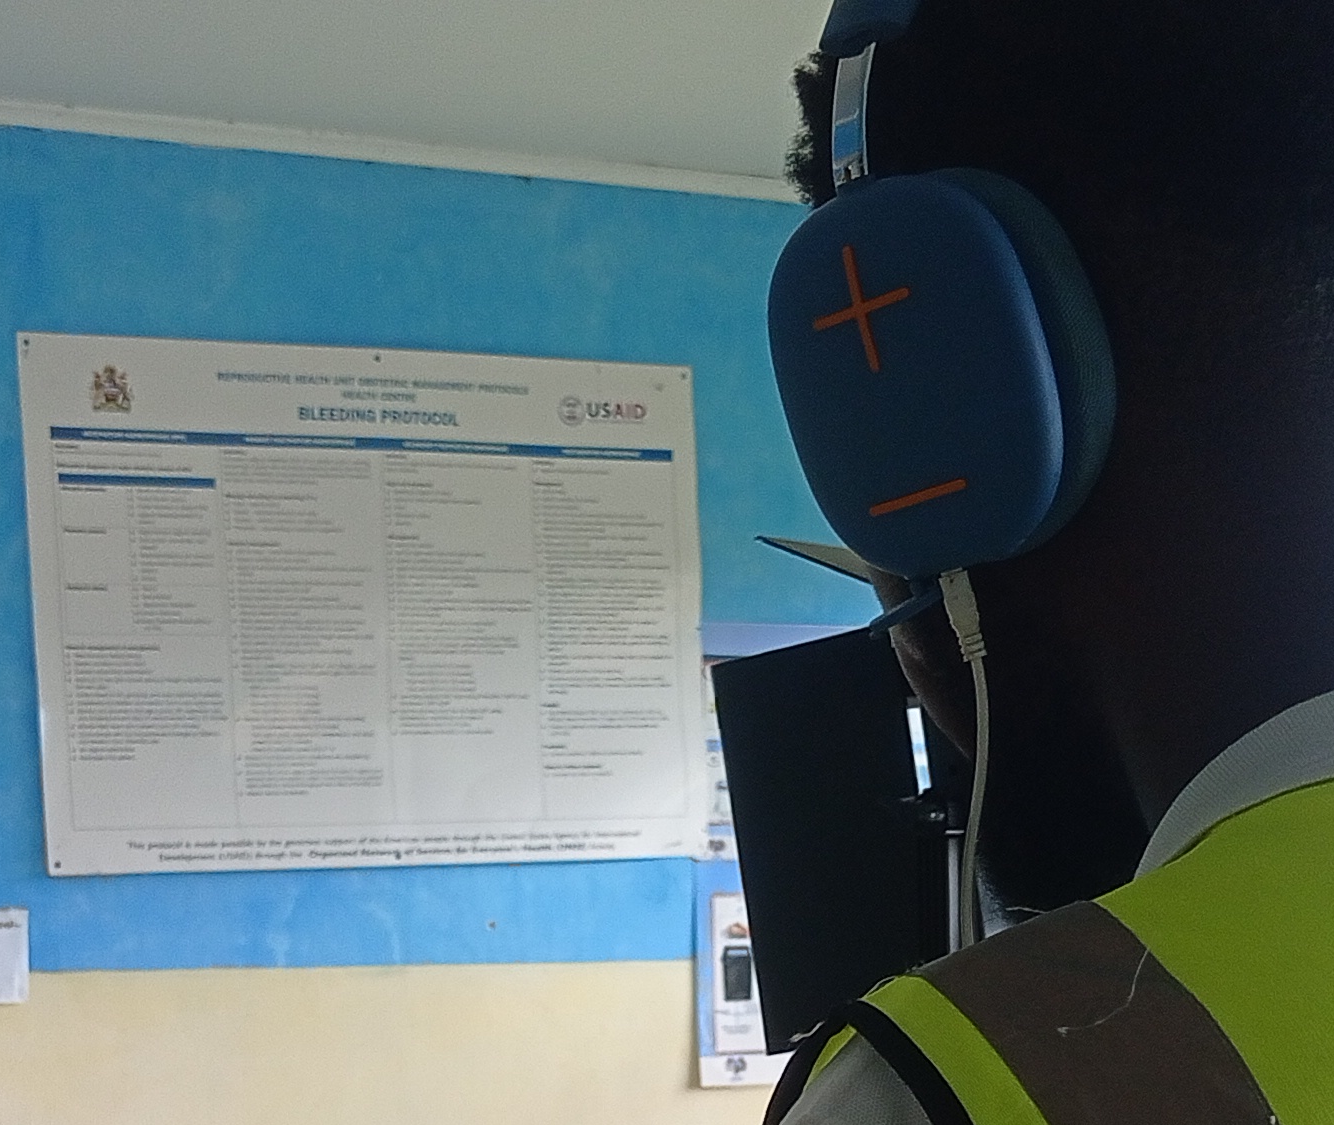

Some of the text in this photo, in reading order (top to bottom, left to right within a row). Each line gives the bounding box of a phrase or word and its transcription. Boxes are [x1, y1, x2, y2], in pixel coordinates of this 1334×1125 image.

[297, 406, 460, 427] BLEEDING PROTOCOL
[586, 402, 647, 419] USAID
